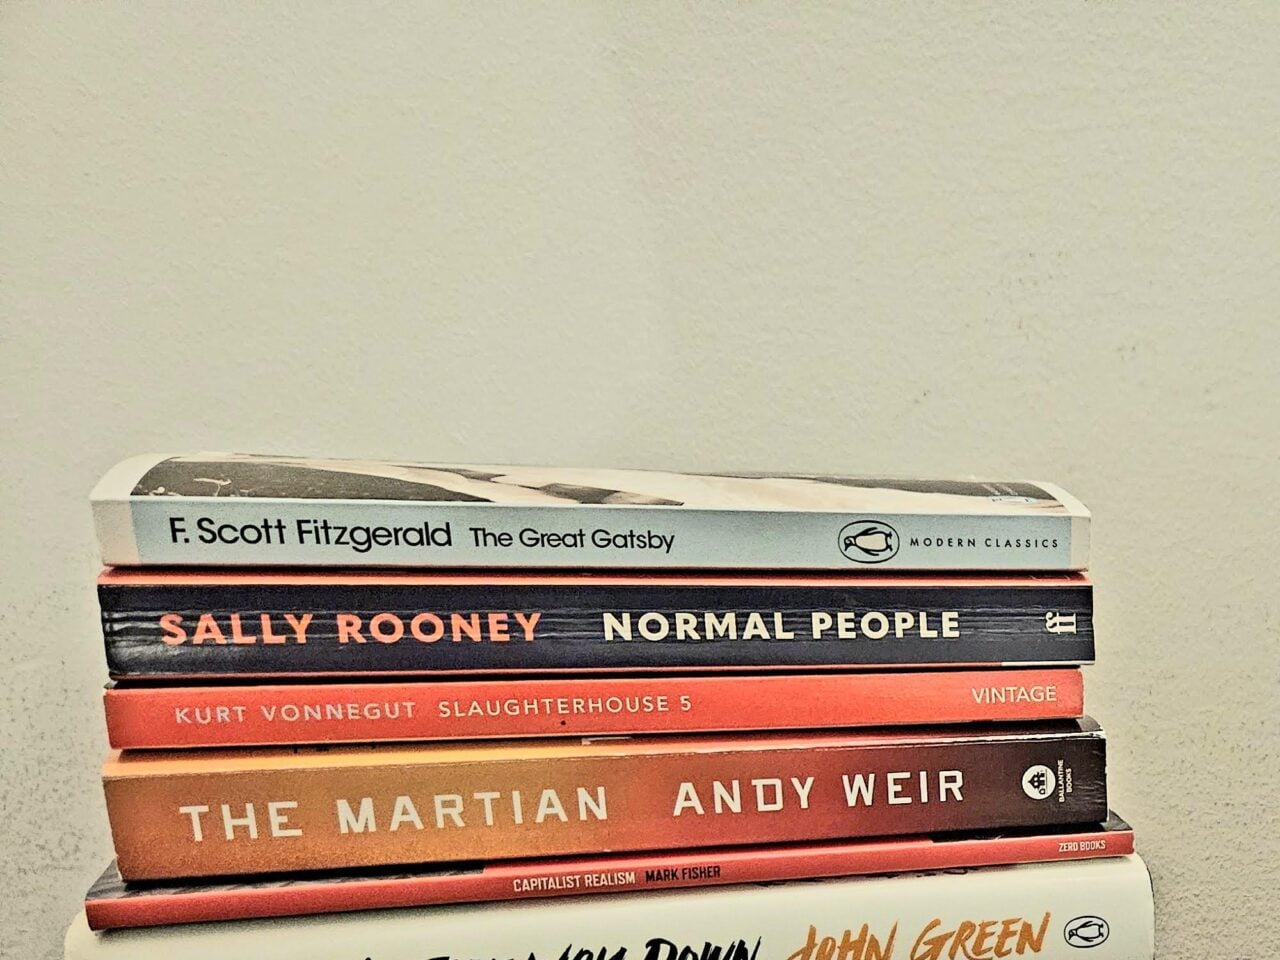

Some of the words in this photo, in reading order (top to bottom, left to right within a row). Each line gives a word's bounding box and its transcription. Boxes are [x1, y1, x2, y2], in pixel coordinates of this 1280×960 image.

[169, 517, 189, 544] F.
[199, 517, 287, 544] Scott
[296, 519, 452, 553] Fitzgerald
[469, 526, 514, 548] The
[519, 528, 585, 549] Great
[591, 529, 675, 554] Gatsby
[909, 537, 977, 549] MODERN
[984, 538, 1058, 549] CLASSICS
[159, 613, 313, 646] SALLY
[337, 612, 542, 644] ROONEY
[603, 611, 794, 641] NORMAL
[812, 610, 960, 639] PEOPLE
[438, 696, 669, 718] SLAUGHTERHOUSE
[680, 695, 692, 712] 5
[971, 685, 1057, 705] VINTAGE
[175, 706, 244, 724] KURT
[260, 701, 416, 722] VONNEGUT
[1065, 768, 1073, 793] BOOKS
[673, 776, 815, 817] ANDY
[842, 770, 965, 808] WEIR
[179, 801, 303, 843] THE
[336, 786, 608, 834] MARTIAN
[1058, 841, 1078, 852] ZERO
[1080, 839, 1106, 851] BOOKS
[513, 874, 581, 892] CAPITALIST
[584, 870, 636, 888] REALISM
[645, 867, 678, 883] MARK
[681, 864, 721, 881] FISHER
